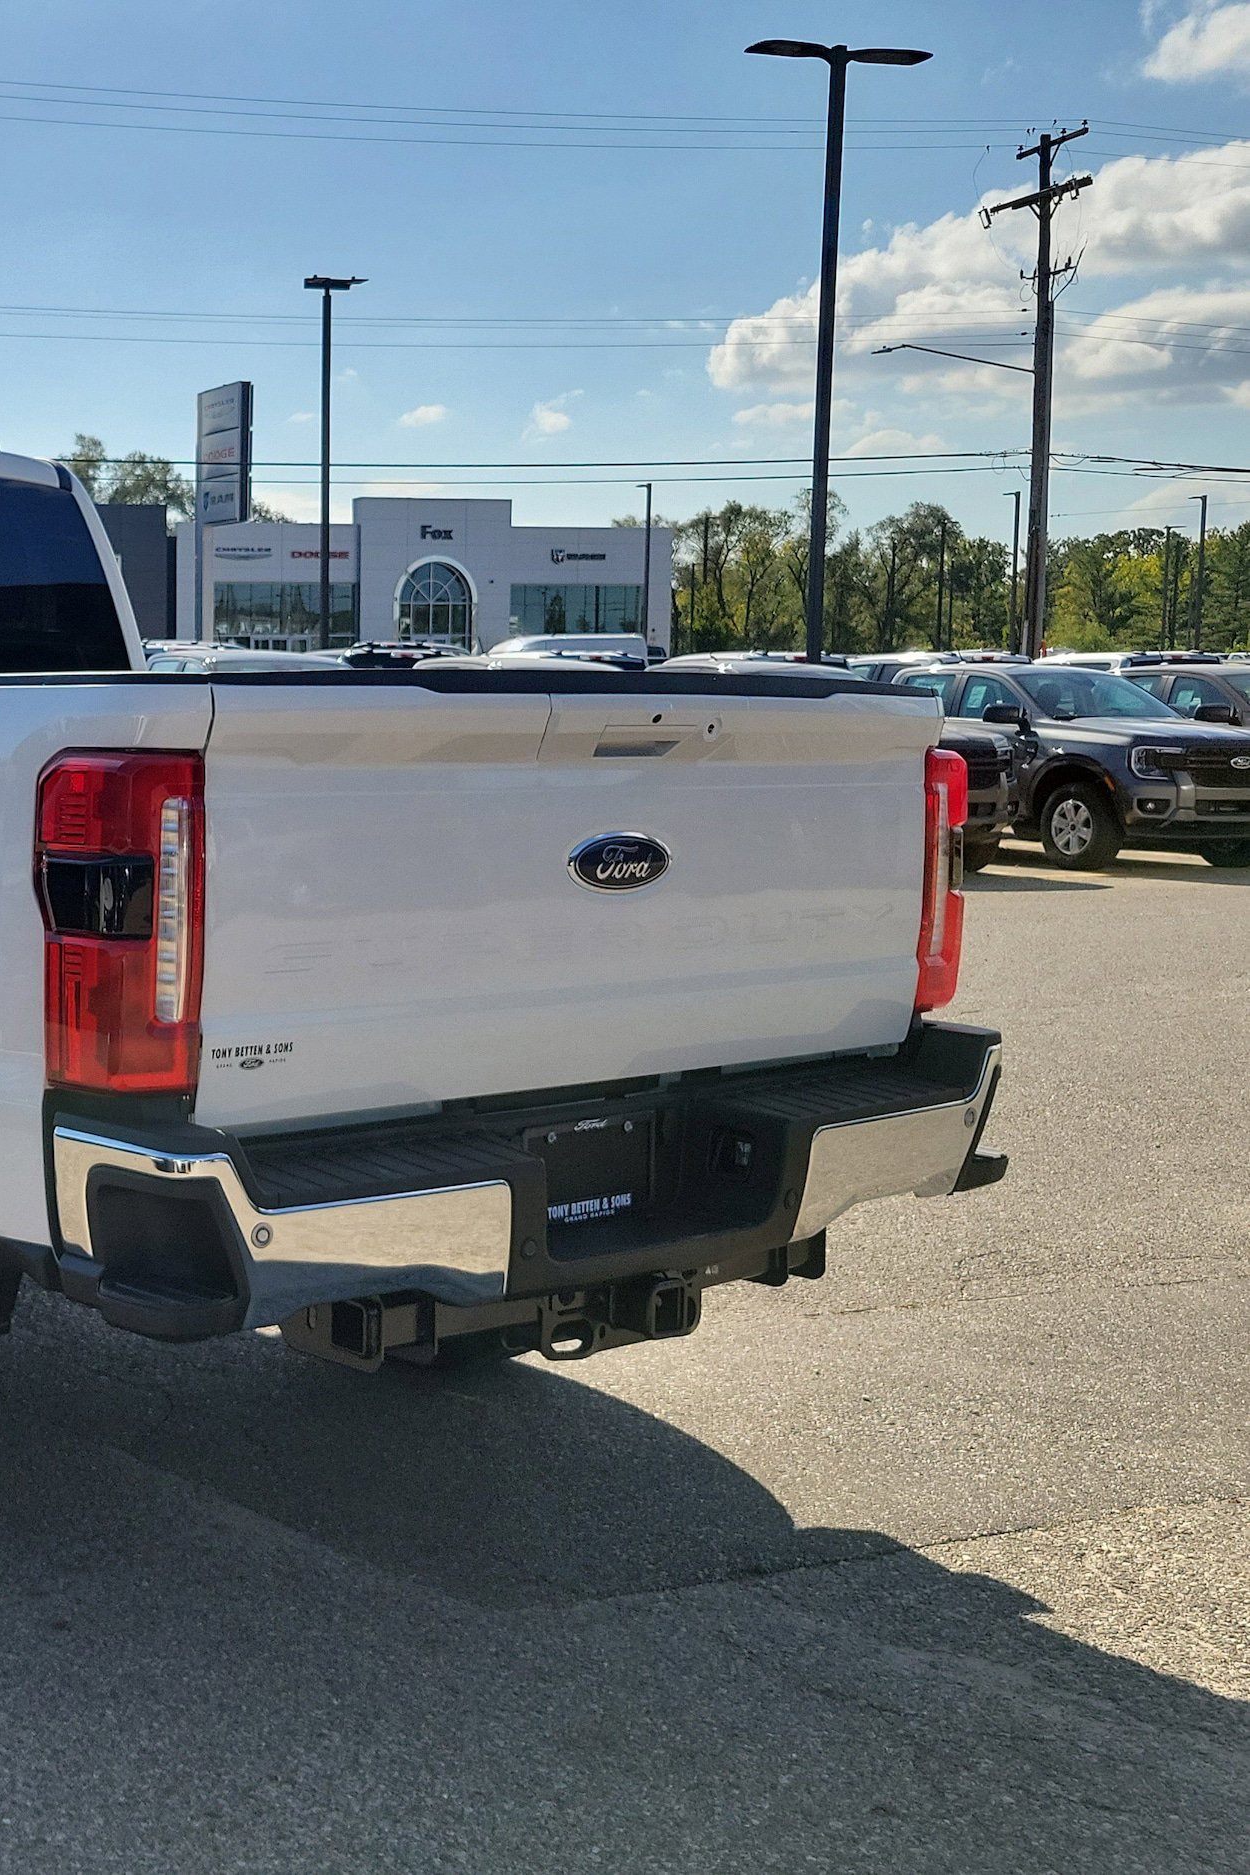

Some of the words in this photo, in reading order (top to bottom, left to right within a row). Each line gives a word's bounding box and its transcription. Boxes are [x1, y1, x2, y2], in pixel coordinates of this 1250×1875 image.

[420, 524, 454, 540] Fox
[595, 844, 653, 880] Ford
[211, 1048, 232, 1059] TONY
[234, 1044, 263, 1057] BETTEN
[265, 1043, 271, 1055] &
[274, 1042, 293, 1054] SONS
[573, 1118, 608, 1131] Ford
[547, 1204, 569, 1219] TONY
[571, 1198, 600, 1215] BETTEN
[602, 1198, 609, 1209] &
[611, 1193, 631, 1208] SONS
